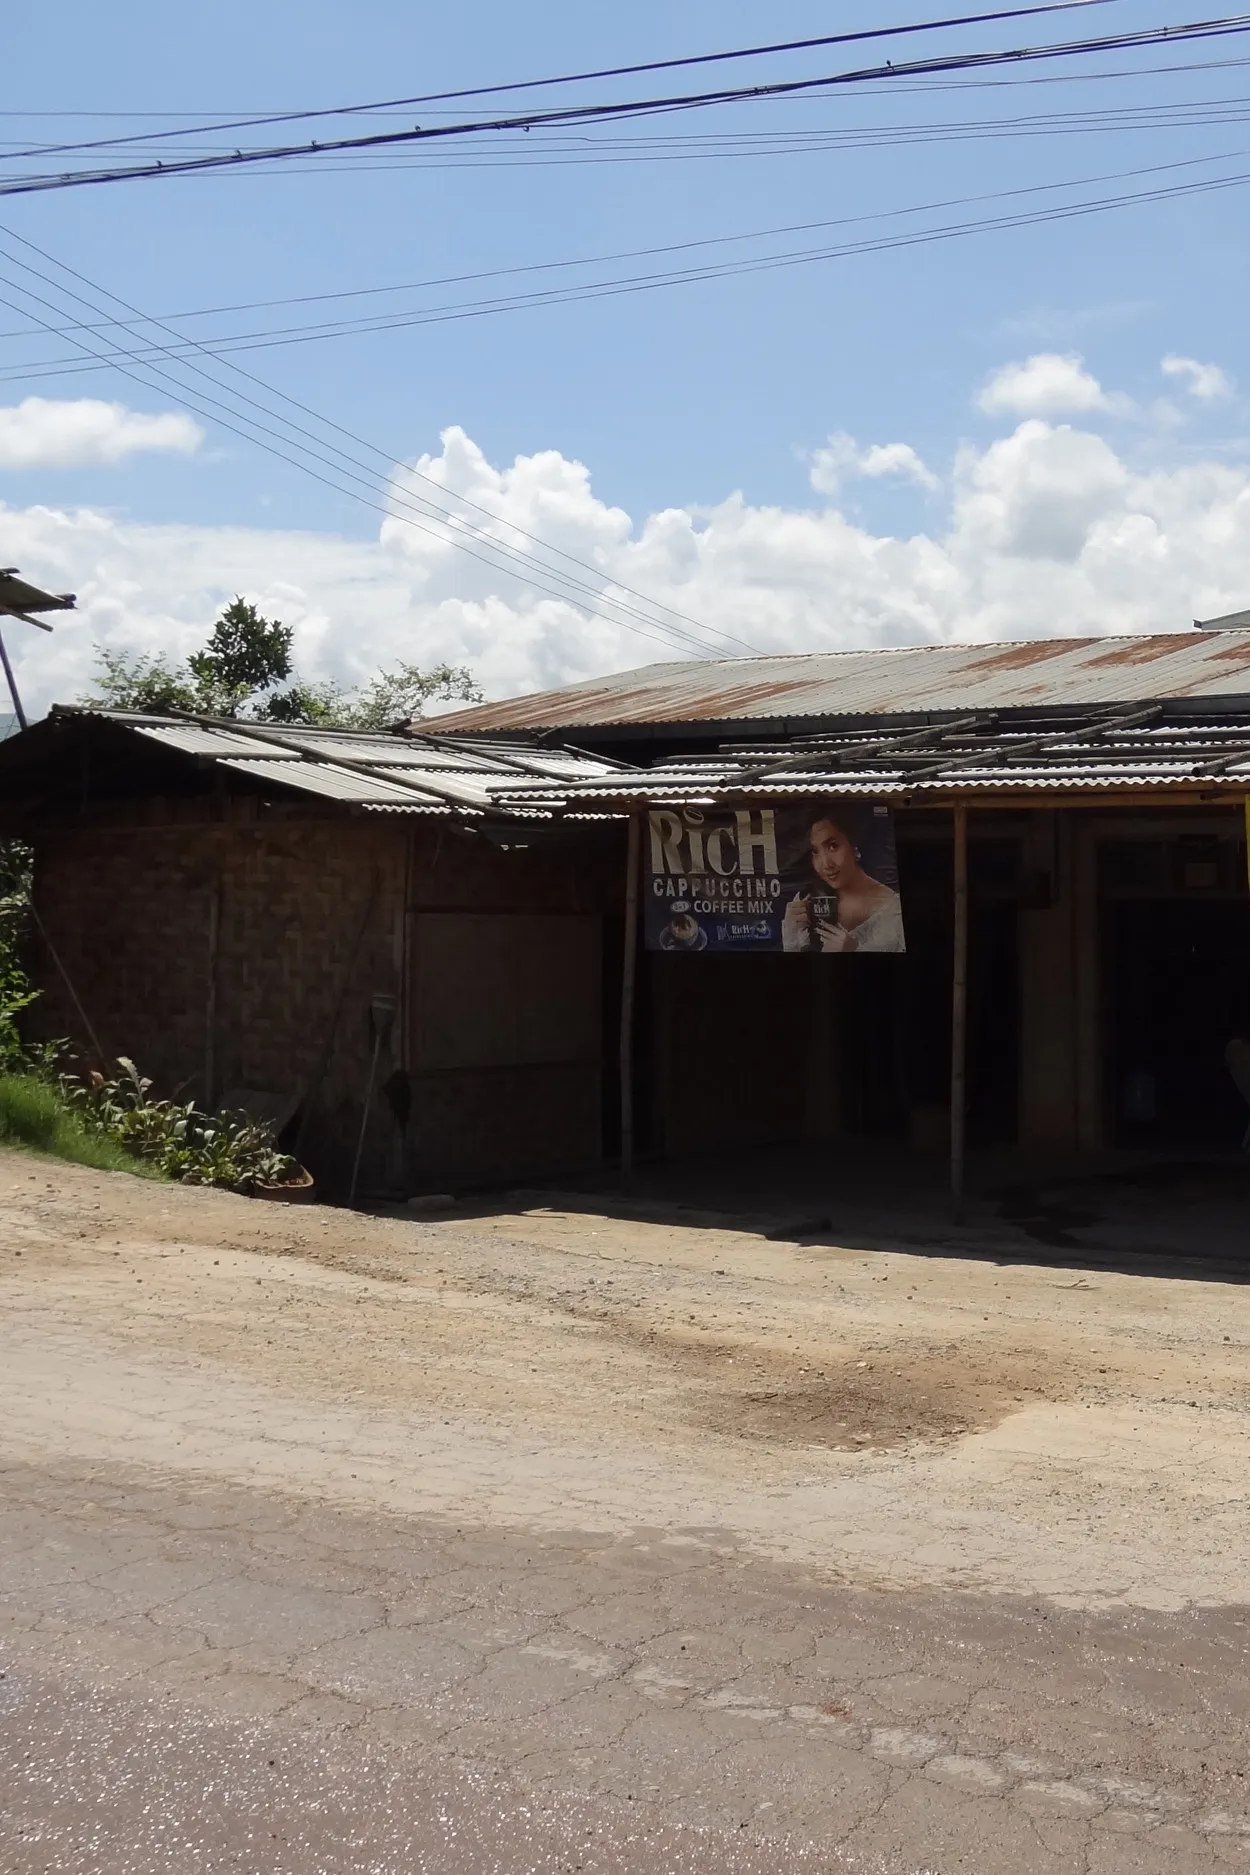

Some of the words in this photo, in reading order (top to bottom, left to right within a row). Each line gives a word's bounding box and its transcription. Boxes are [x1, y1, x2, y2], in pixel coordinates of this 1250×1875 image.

[653, 878, 781, 899] CAPPUCCINO
[693, 900, 744, 913] COFFEE
[748, 900, 774, 914] MIX
